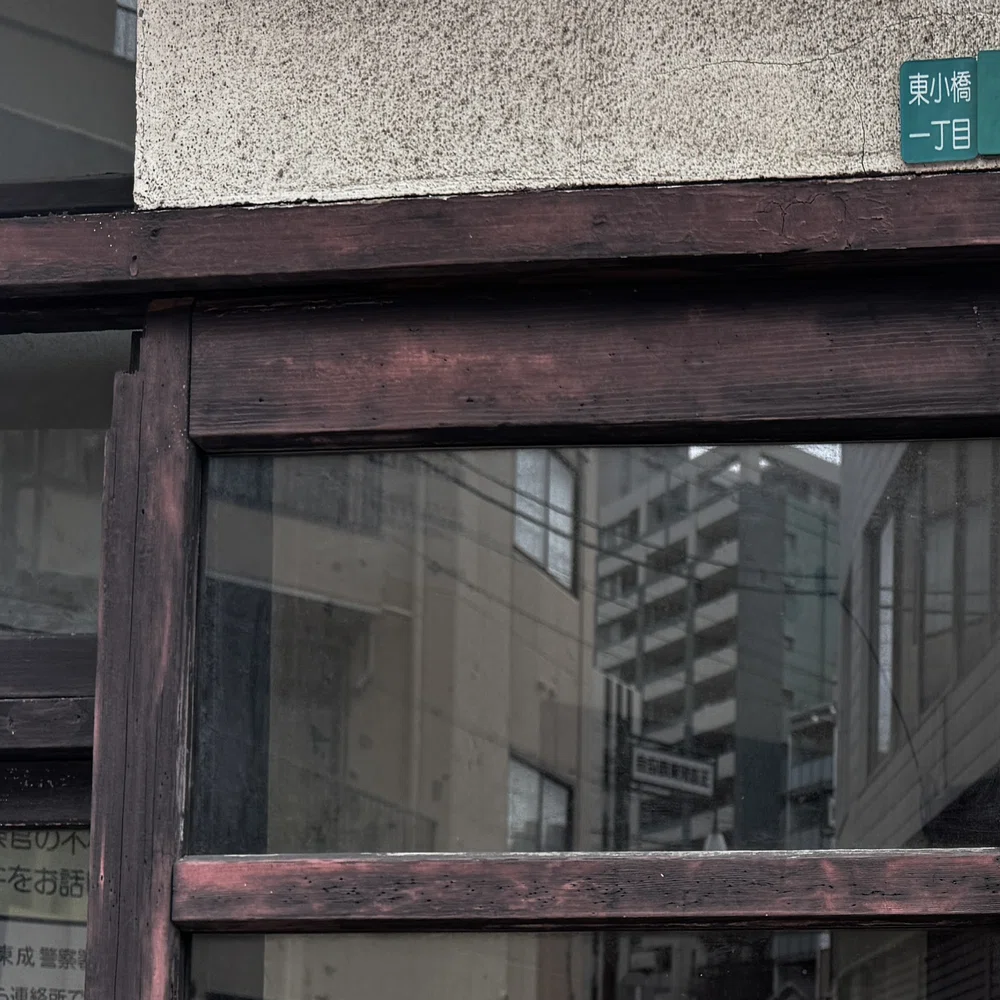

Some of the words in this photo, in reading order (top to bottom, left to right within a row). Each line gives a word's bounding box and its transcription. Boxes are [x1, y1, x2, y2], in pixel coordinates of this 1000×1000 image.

[908, 70, 971, 106] 東小橋
[909, 118, 970, 150] 一丁目
[0, 865, 89, 897] をお話
